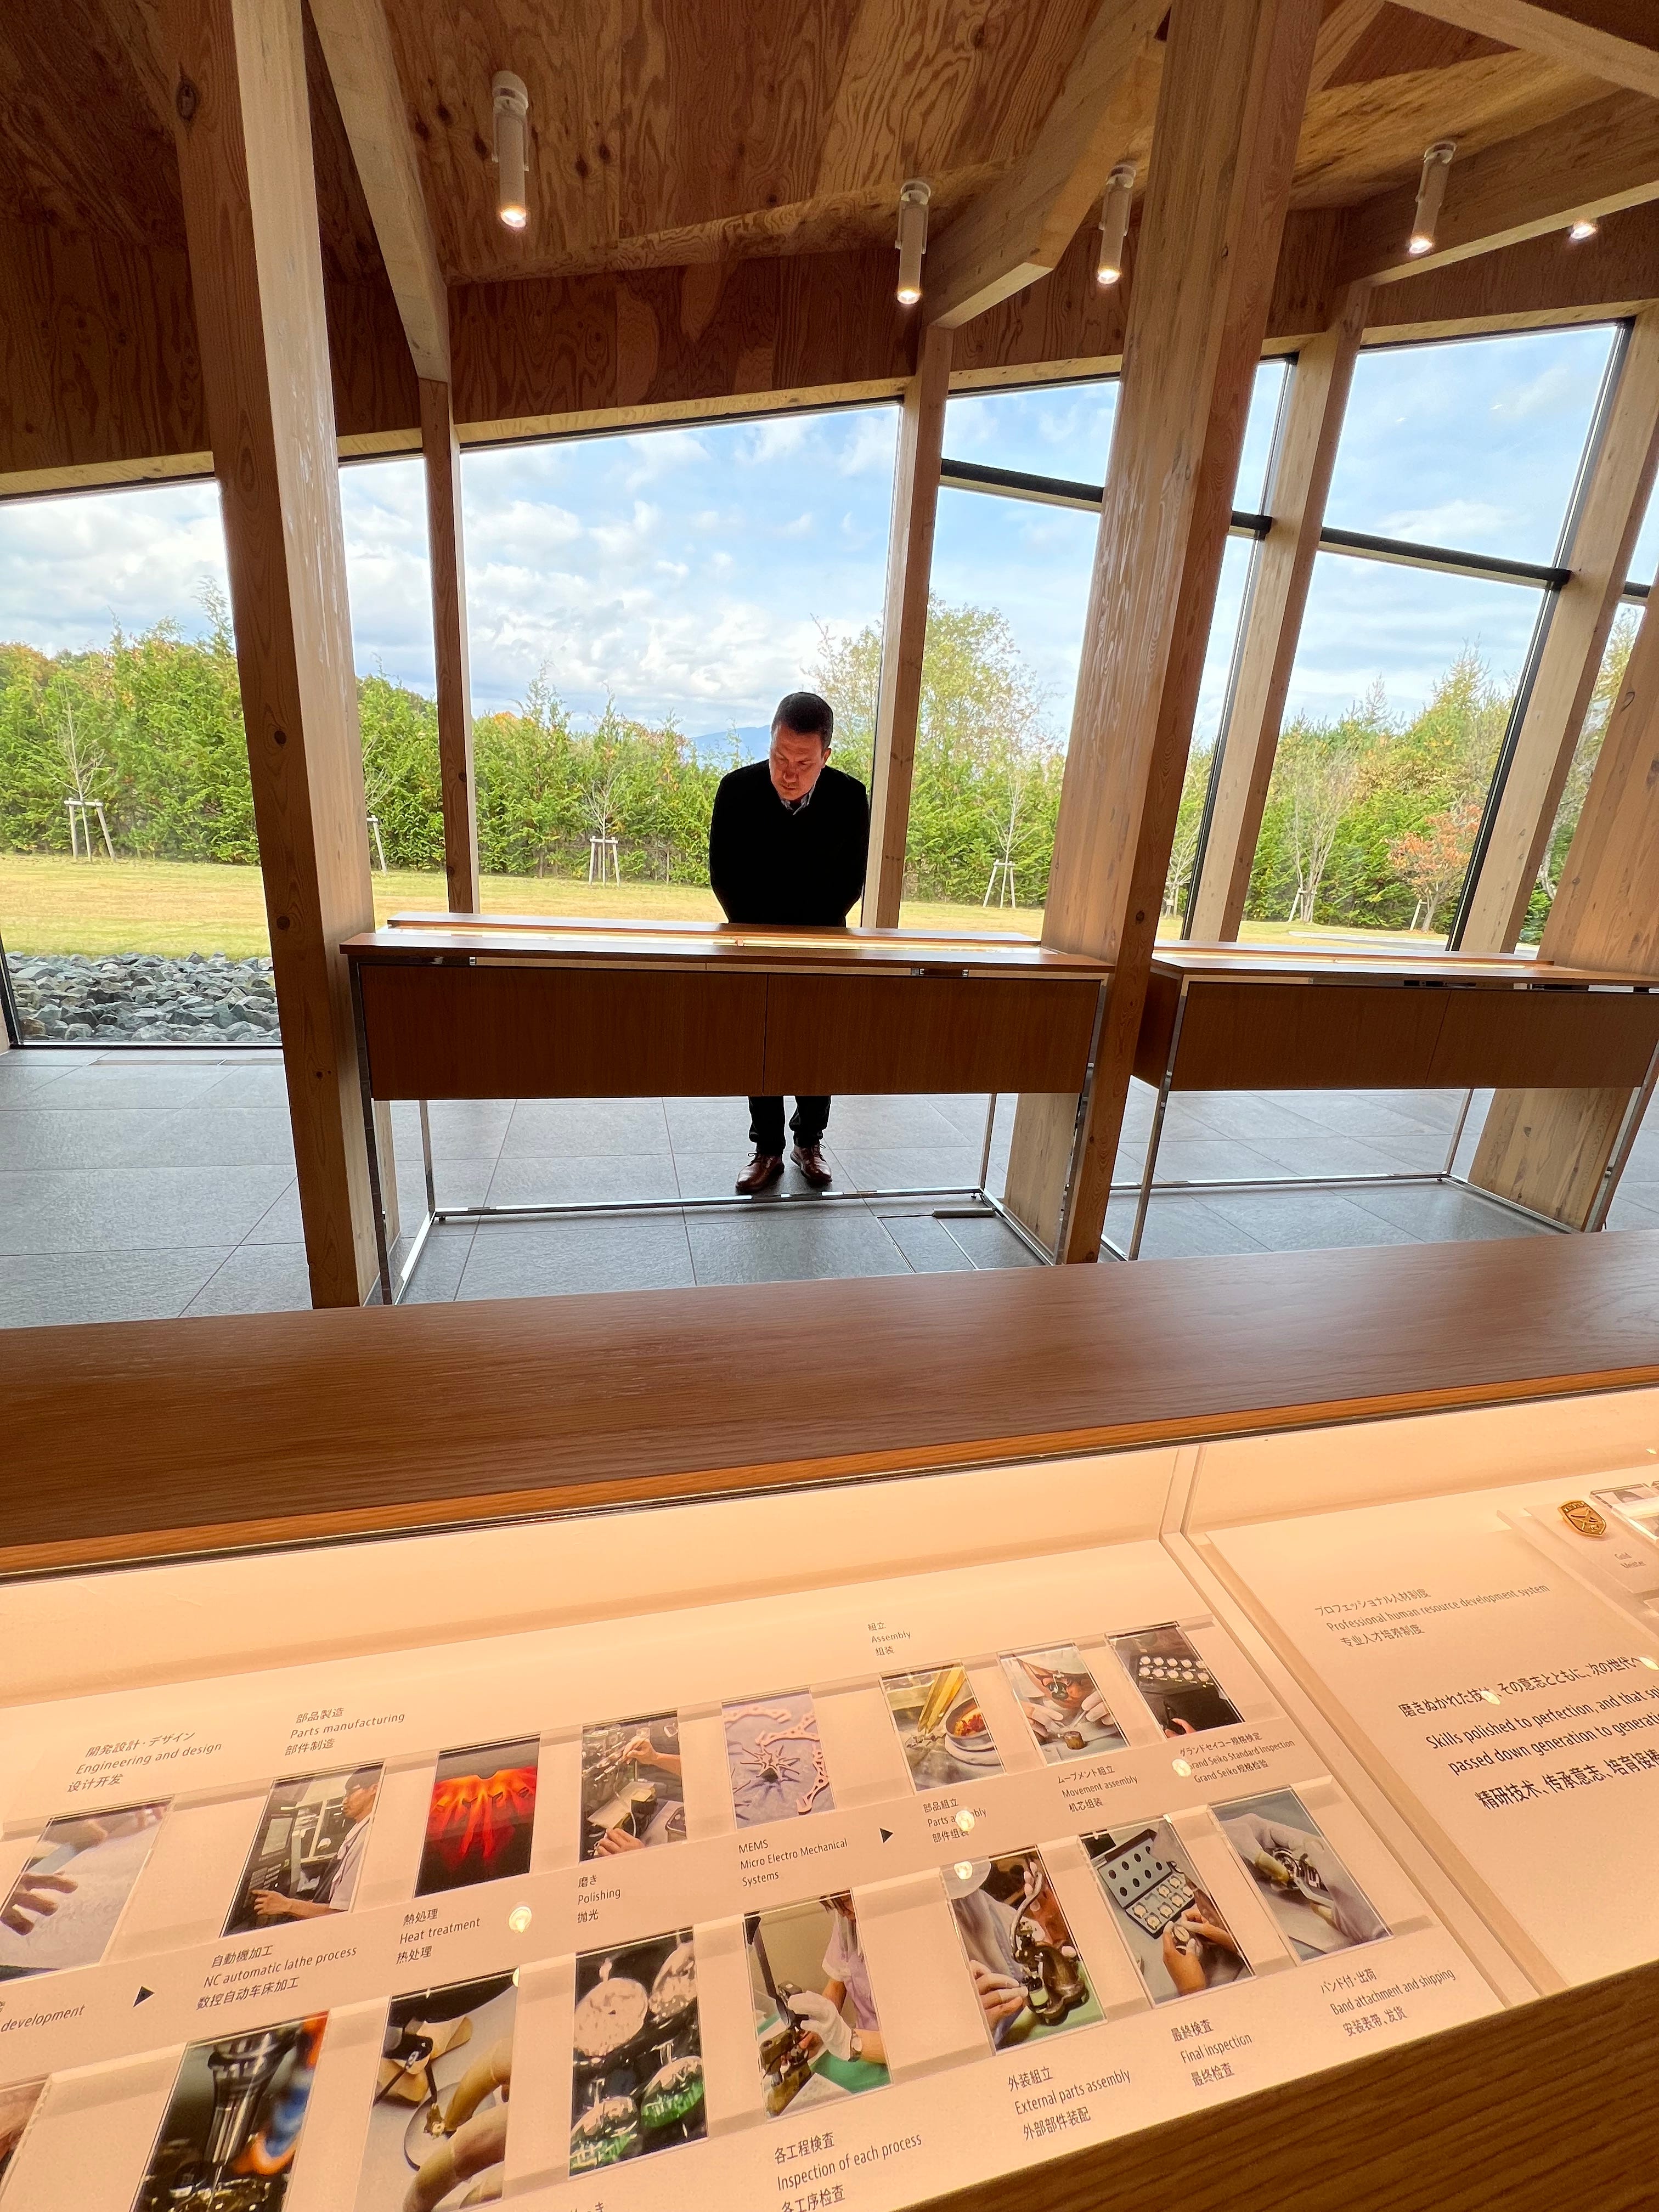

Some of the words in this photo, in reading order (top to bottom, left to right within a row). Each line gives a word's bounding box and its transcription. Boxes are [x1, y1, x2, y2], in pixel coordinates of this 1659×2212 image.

[1315, 1588, 1431, 1616] プロフェッショナル人材制度
[1327, 1613, 1386, 1631] Professional
[1385, 1609, 1420, 1621] human
[1420, 1601, 1460, 1615] resource
[1460, 1590, 1519, 1607] development
[1518, 1584, 1550, 1597] system
[868, 1622, 886, 1630] 組立
[872, 1630, 910, 1643] Assembly
[1340, 1624, 1425, 1647] 专业人才培养制度
[876, 1646, 894, 1656] 组装
[1398, 1656, 1641, 1718] 磨きぬかれた技、その意志とともに、次の世代へ
[290, 1728, 319, 1739] Parts
[323, 1714, 405, 1733] manufacturing
[296, 1707, 344, 1724] 部品製造
[1426, 1731, 1463, 1749] Skills
[1463, 1718, 1516, 1745] polished
[1516, 1717, 1533, 1729] to
[1532, 1701, 1599, 1728] perfection,
[1596, 1695, 1622, 1710] and
[1616, 1690, 1647, 1705] that
[285, 1738, 335, 1756] 部件制造
[1208, 1754, 1228, 1765] Seiko
[1227, 1746, 1260, 1760] Standard
[1261, 1740, 1295, 1754] Inspection
[1448, 1751, 1494, 1775] passed
[1494, 1744, 1533, 1762] down
[1531, 1729, 1598, 1756] generation
[1593, 1726, 1613, 1737] to
[1612, 1712, 1659, 1736] generati
[76, 1755, 151, 1774] Engineering
[155, 1748, 179, 1761] and
[183, 1743, 222, 1756] design
[67, 1774, 123, 1792] 设计开发
[1058, 1765, 1115, 1784] ムーブメント組立
[1194, 1771, 1217, 1782] Grand
[1062, 1783, 1103, 1798] Movement
[1105, 1775, 1138, 1789] assembly
[923, 1798, 959, 1813] 部品組立
[1069, 1797, 1103, 1813] 机芯组装
[928, 1816, 948, 1827] Parts
[951, 1808, 986, 1822] ably
[739, 1839, 769, 1854] MEMS
[740, 1857, 765, 1870] Micro
[768, 1850, 798, 1864] Electro
[800, 1838, 848, 1857] Mechanical
[578, 1875, 597, 1888] 磨き
[742, 1871, 779, 1887] Systems
[578, 1889, 620, 1905] Polishing
[403, 1908, 438, 1926] 熱処理
[578, 1909, 599, 1923] 抛光
[399, 1930, 424, 1944] Heat
[428, 1918, 481, 1937] treatment
[212, 1945, 274, 1968] 自動機加工
[396, 1945, 432, 1965] 热处理
[204, 1974, 222, 1988] NC
[223, 1962, 281, 1984] automatic
[284, 1956, 312, 1971] lathe
[315, 1948, 357, 1966] process
[196, 1977, 300, 2010] 数控自动车床加工
[1330, 1997, 1355, 2015] Band
[1355, 1984, 1403, 2007] attachment
[1404, 1978, 1419, 1993] and
[1420, 1969, 1455, 1987] shipping
[1, 2004, 85, 2032] development
[1171, 2019, 1214, 2042] 最終検査
[1181, 2045, 1204, 2063] Final
[1204, 2034, 1252, 2056] inspection
[1008, 2066, 1053, 2092] 外装組立
[1191, 2063, 1234, 2086] 最终检查
[1015, 2090, 1057, 2115] External
[1059, 2085, 1085, 2104] parts
[1087, 2068, 1131, 2092] assembly
[1023, 2107, 1091, 2141] 外部部件装配
[775, 2131, 834, 2165] 各工程検査
[777, 2162, 836, 2191] Inspection
[839, 2153, 850, 2170] of
[854, 2145, 878, 2165] each
[882, 2134, 922, 2160] process
